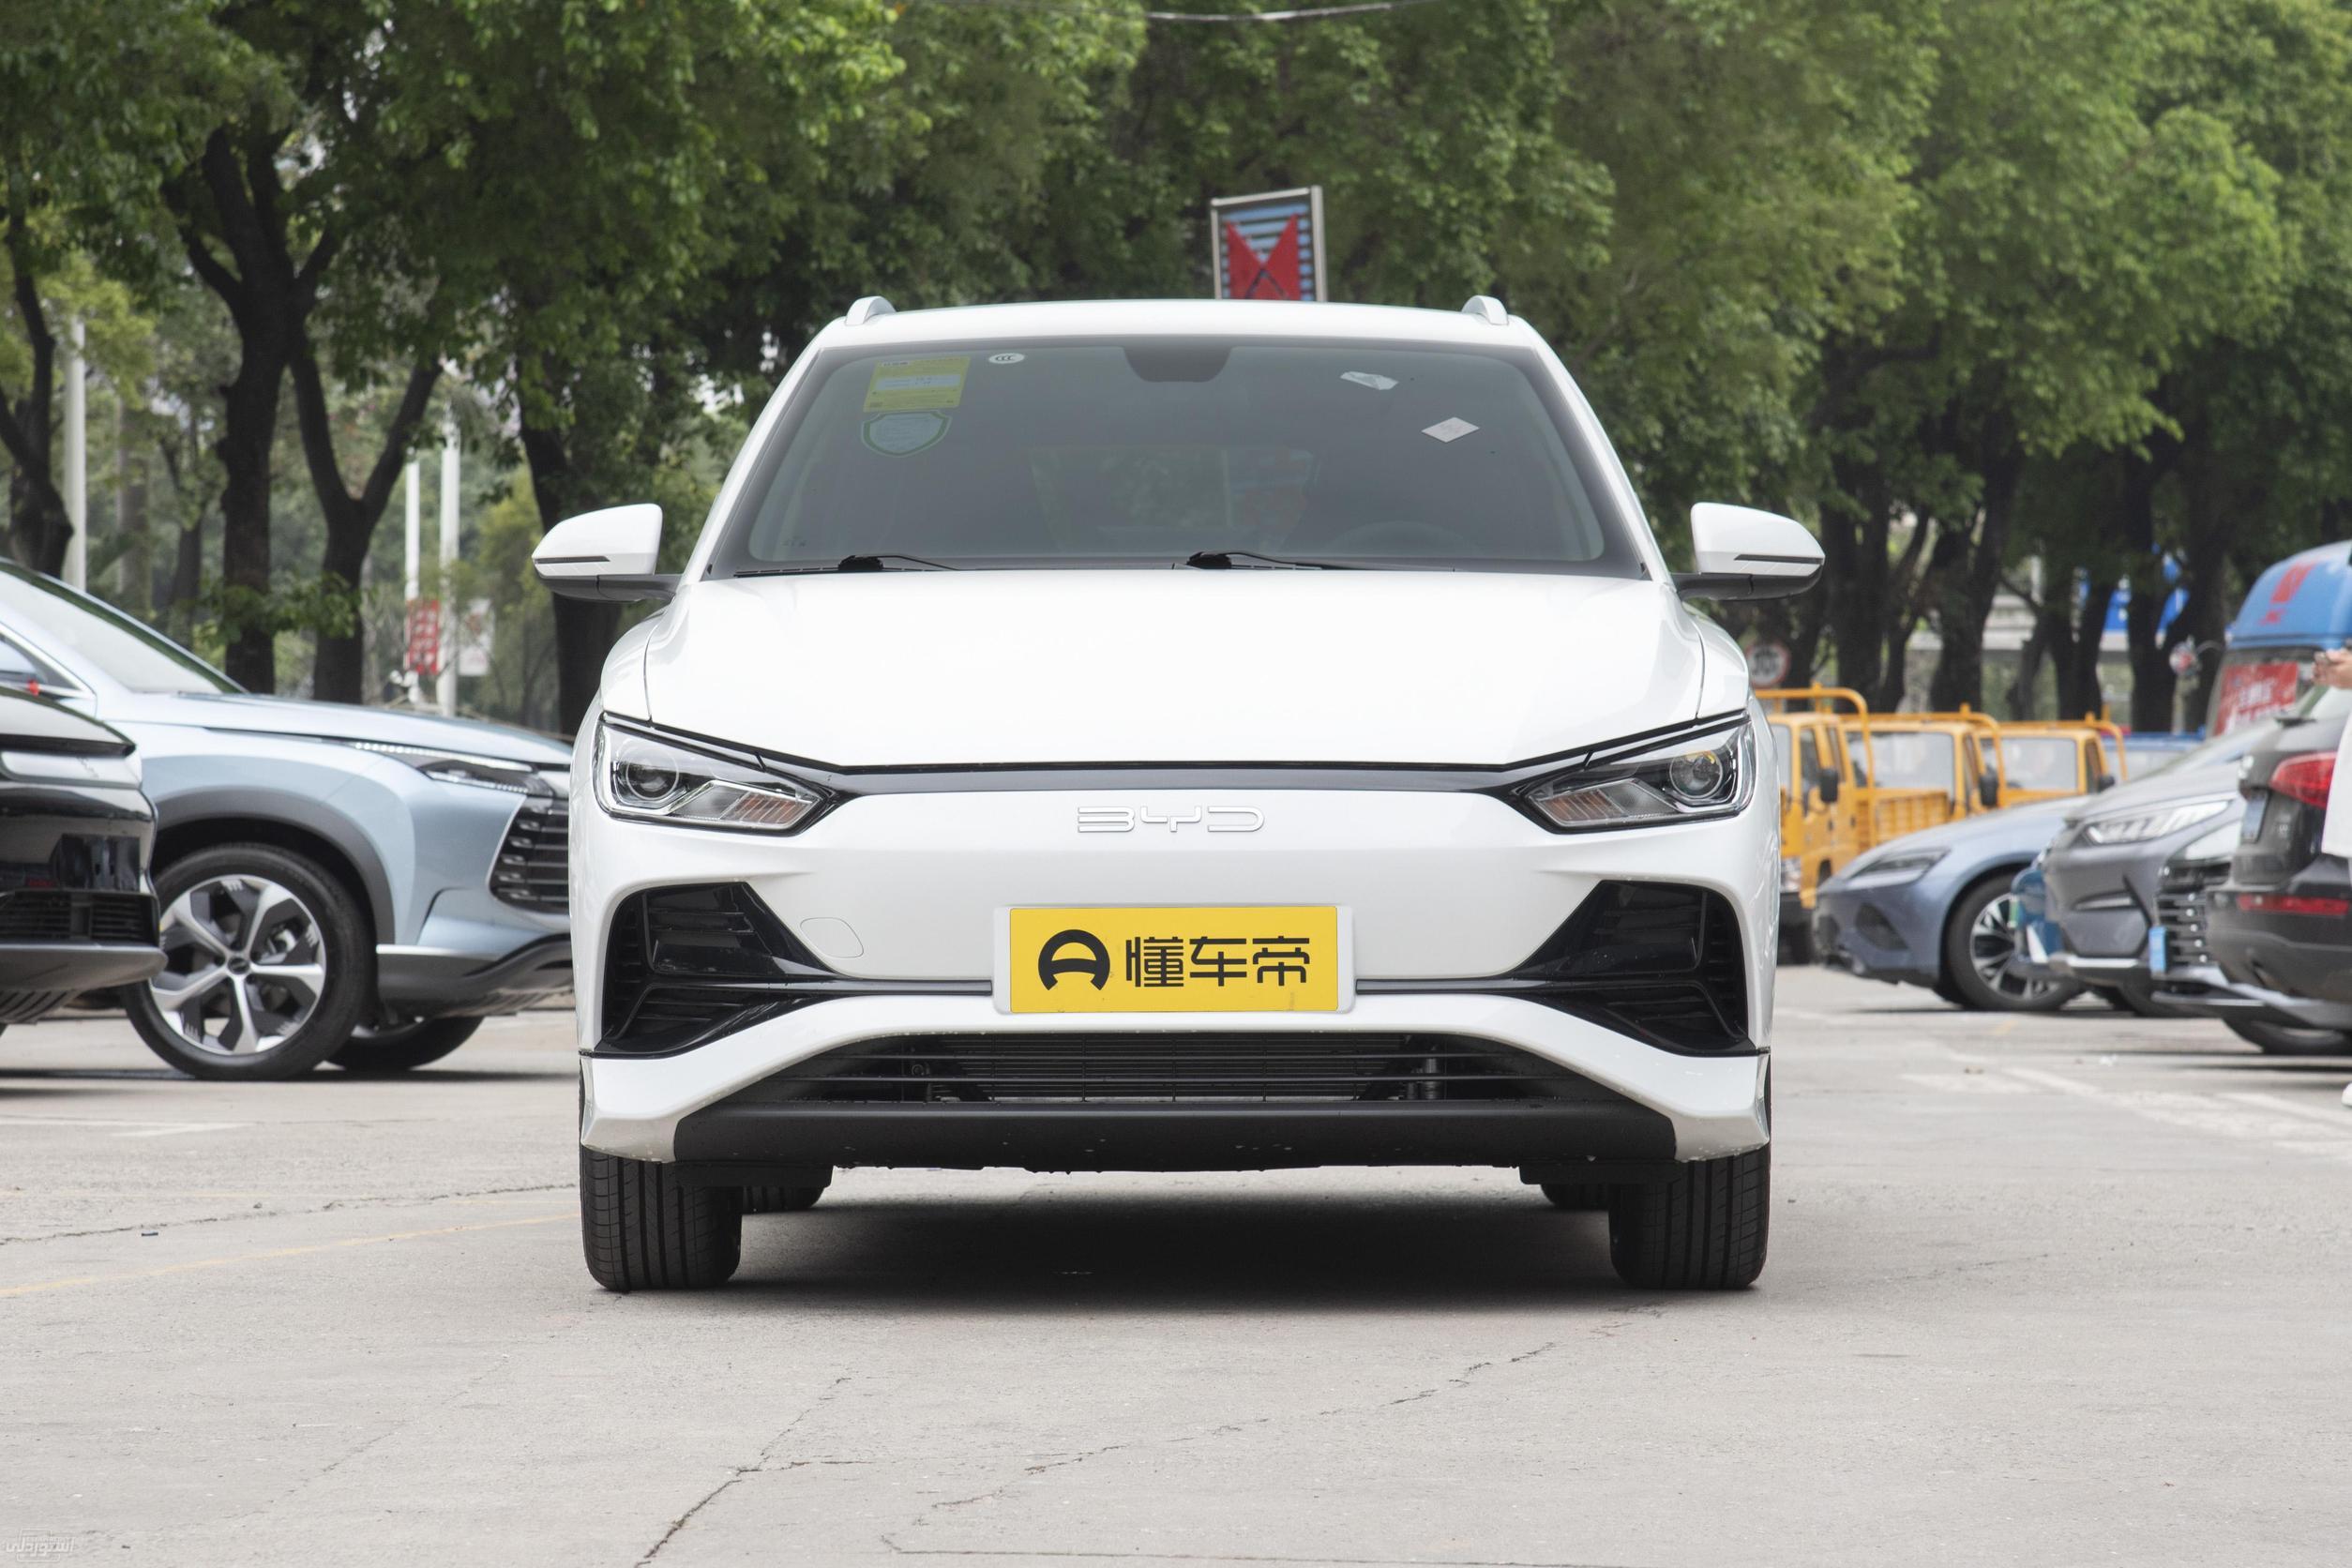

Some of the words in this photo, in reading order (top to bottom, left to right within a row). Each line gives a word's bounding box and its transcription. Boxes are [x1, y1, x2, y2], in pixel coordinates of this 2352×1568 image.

[1077, 806, 1265, 833] BYD
[1125, 936, 1310, 988] 懂车帝
